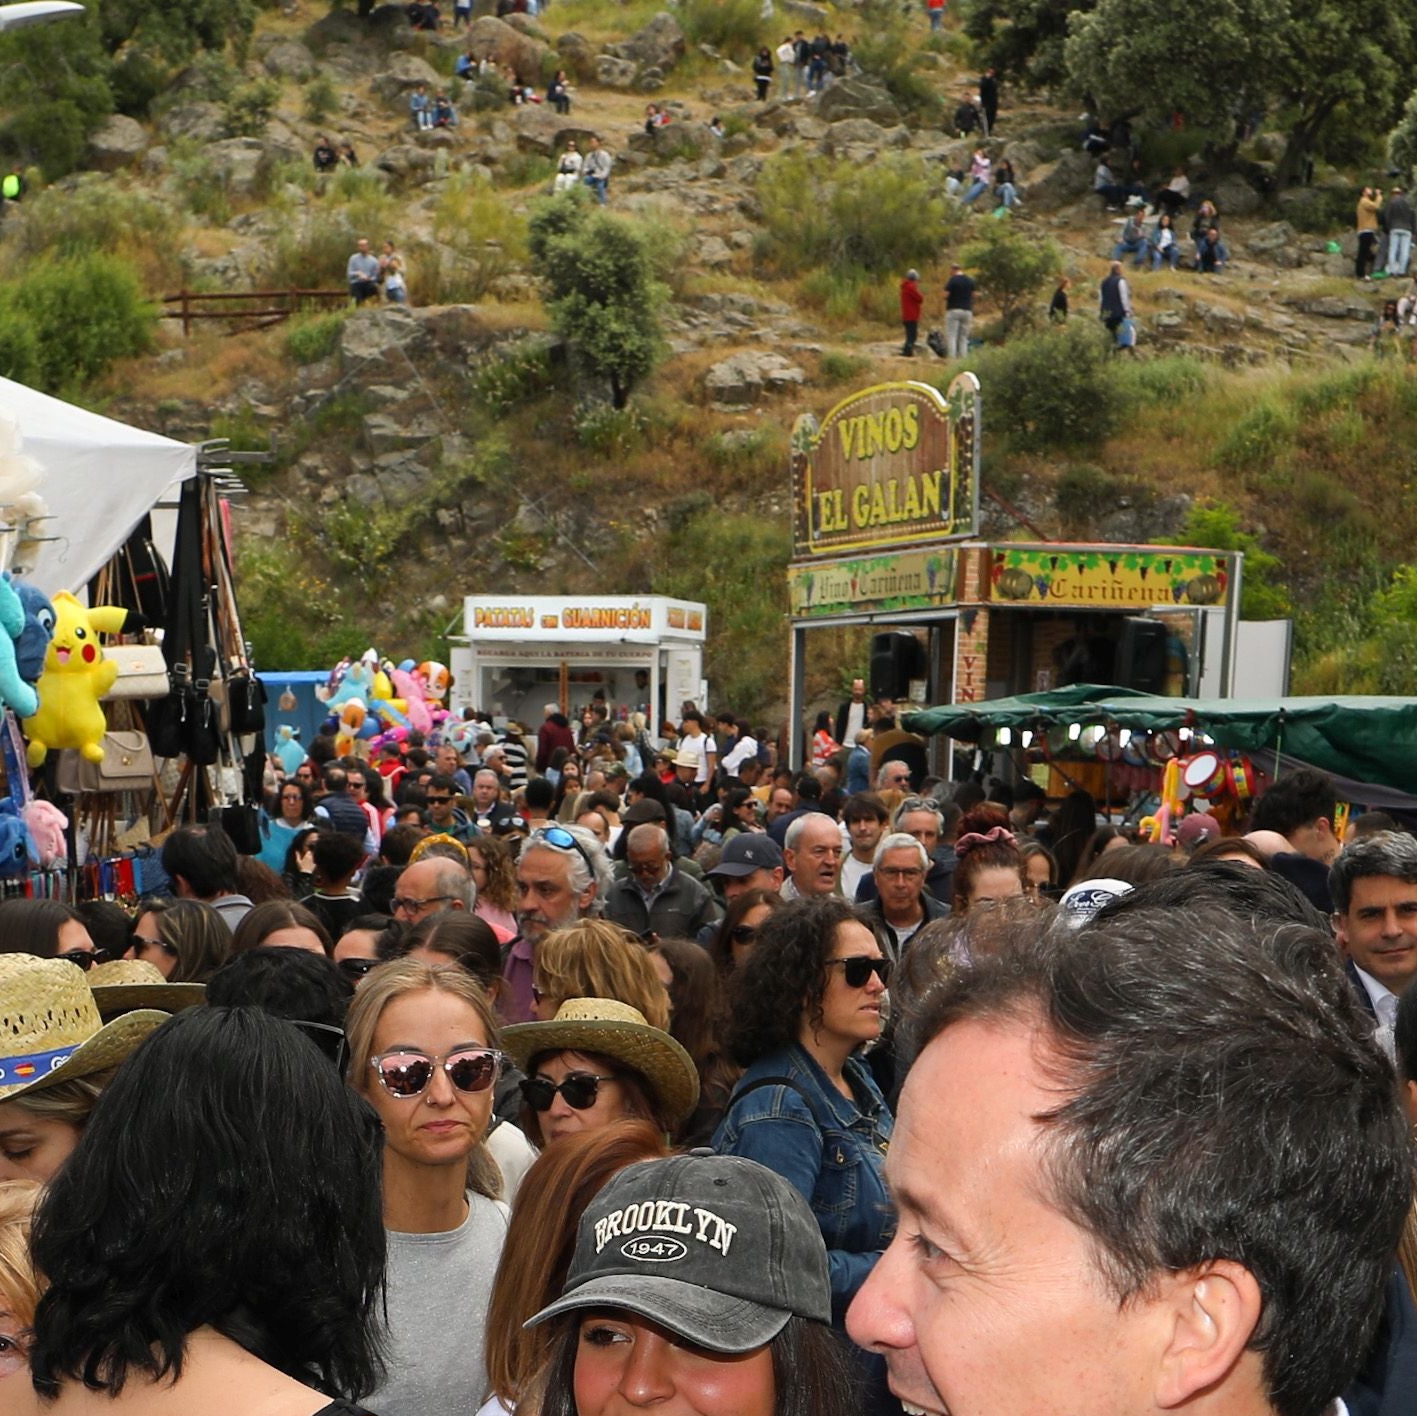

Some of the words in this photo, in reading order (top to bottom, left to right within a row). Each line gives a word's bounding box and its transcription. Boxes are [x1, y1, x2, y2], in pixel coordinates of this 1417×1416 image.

[838, 403, 919, 461] VINOS
[819, 488, 849, 533] EL
[852, 469, 942, 529] GALAN
[1048, 578, 1170, 602] Cariñena
[473, 606, 535, 628] PATATAS
[561, 602, 651, 629] GUARNICIÓN
[594, 1200, 737, 1257] BROOKLYN
[629, 1243, 679, 1256] 1947
